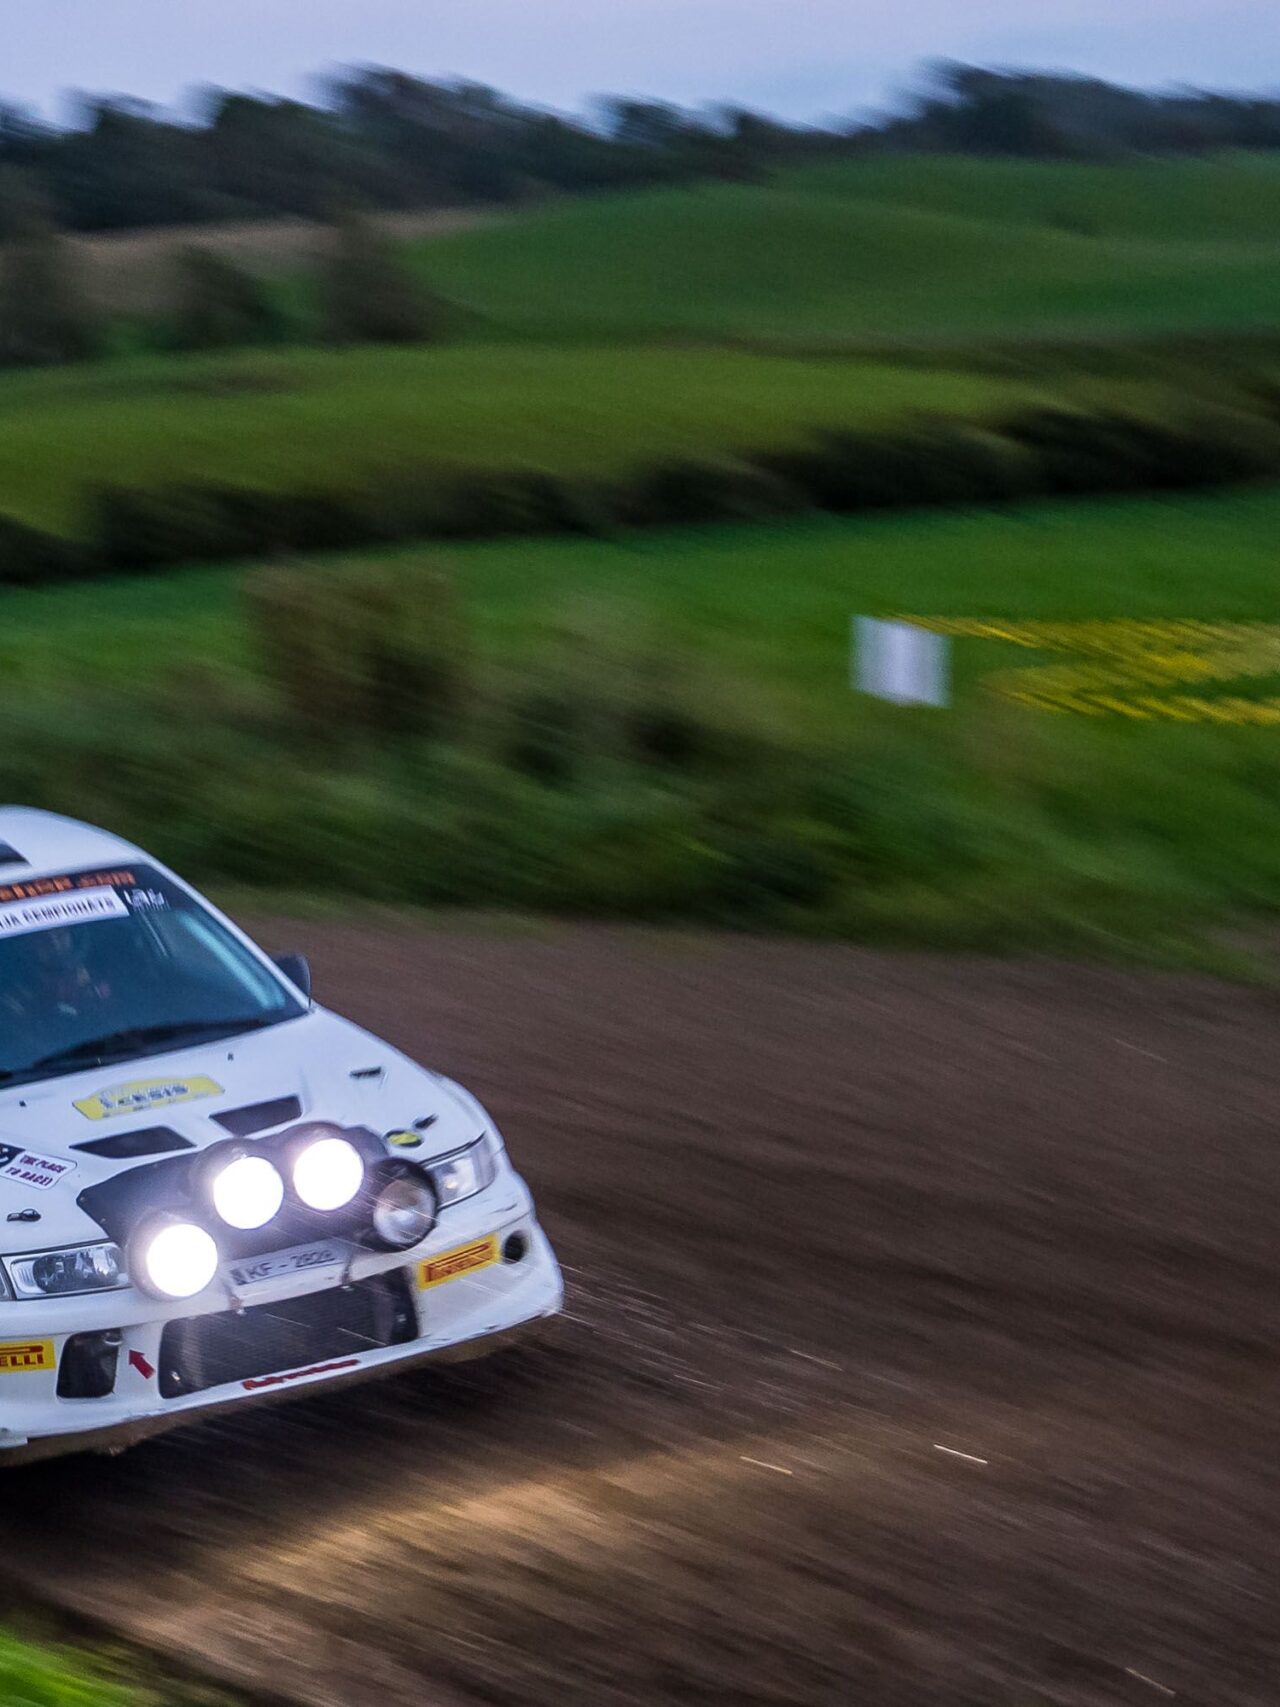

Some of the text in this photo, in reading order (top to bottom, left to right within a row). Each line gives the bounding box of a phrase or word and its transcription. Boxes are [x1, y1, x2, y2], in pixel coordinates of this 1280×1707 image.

[5, 1166, 20, 1176] TO
[20, 1154, 67, 1174] THE PLACE
